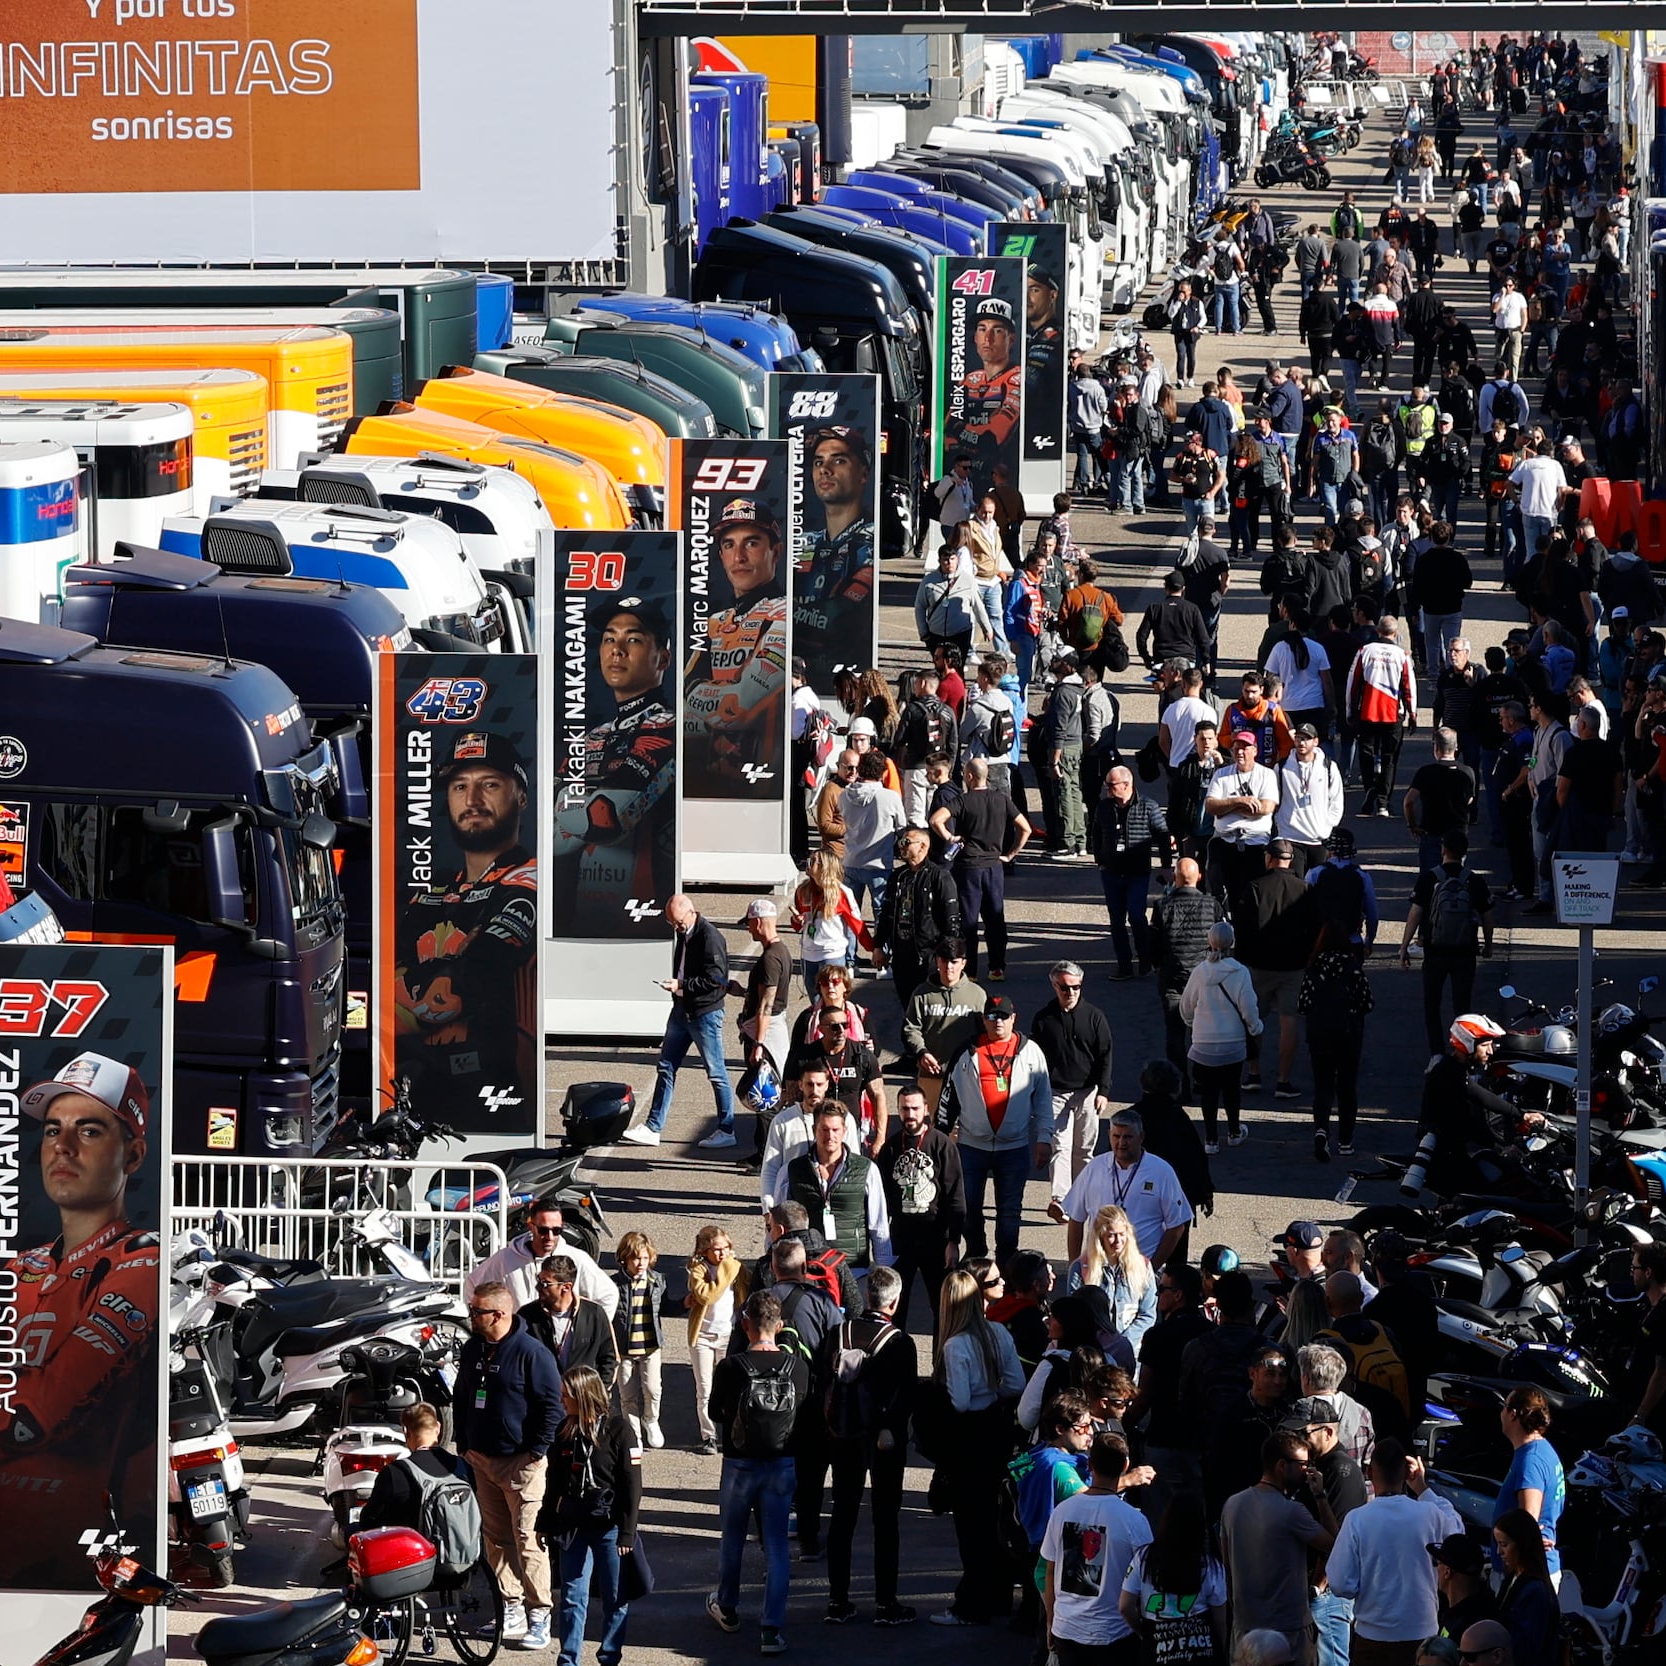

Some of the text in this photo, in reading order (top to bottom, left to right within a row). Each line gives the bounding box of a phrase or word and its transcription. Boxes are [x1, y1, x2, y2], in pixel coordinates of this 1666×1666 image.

[116, 0, 178, 26] por
[91, 110, 233, 141] sonrisas
[952, 270, 995, 294] 41
[950, 297, 968, 421] Aleix ESPARGARO
[789, 390, 839, 420] 88
[691, 457, 767, 492] 93
[565, 551, 626, 592] 30
[689, 495, 711, 652] Marc MARQUEZ
[405, 678, 488, 725] 43
[565, 597, 588, 809] Takaaki NAKAGAMI
[408, 730, 432, 892] Jack MILLER
[99, 1292, 134, 1315] elf
[192, 1496, 225, 1515] 50119
[1177, 1634, 1214, 1649] FACE
